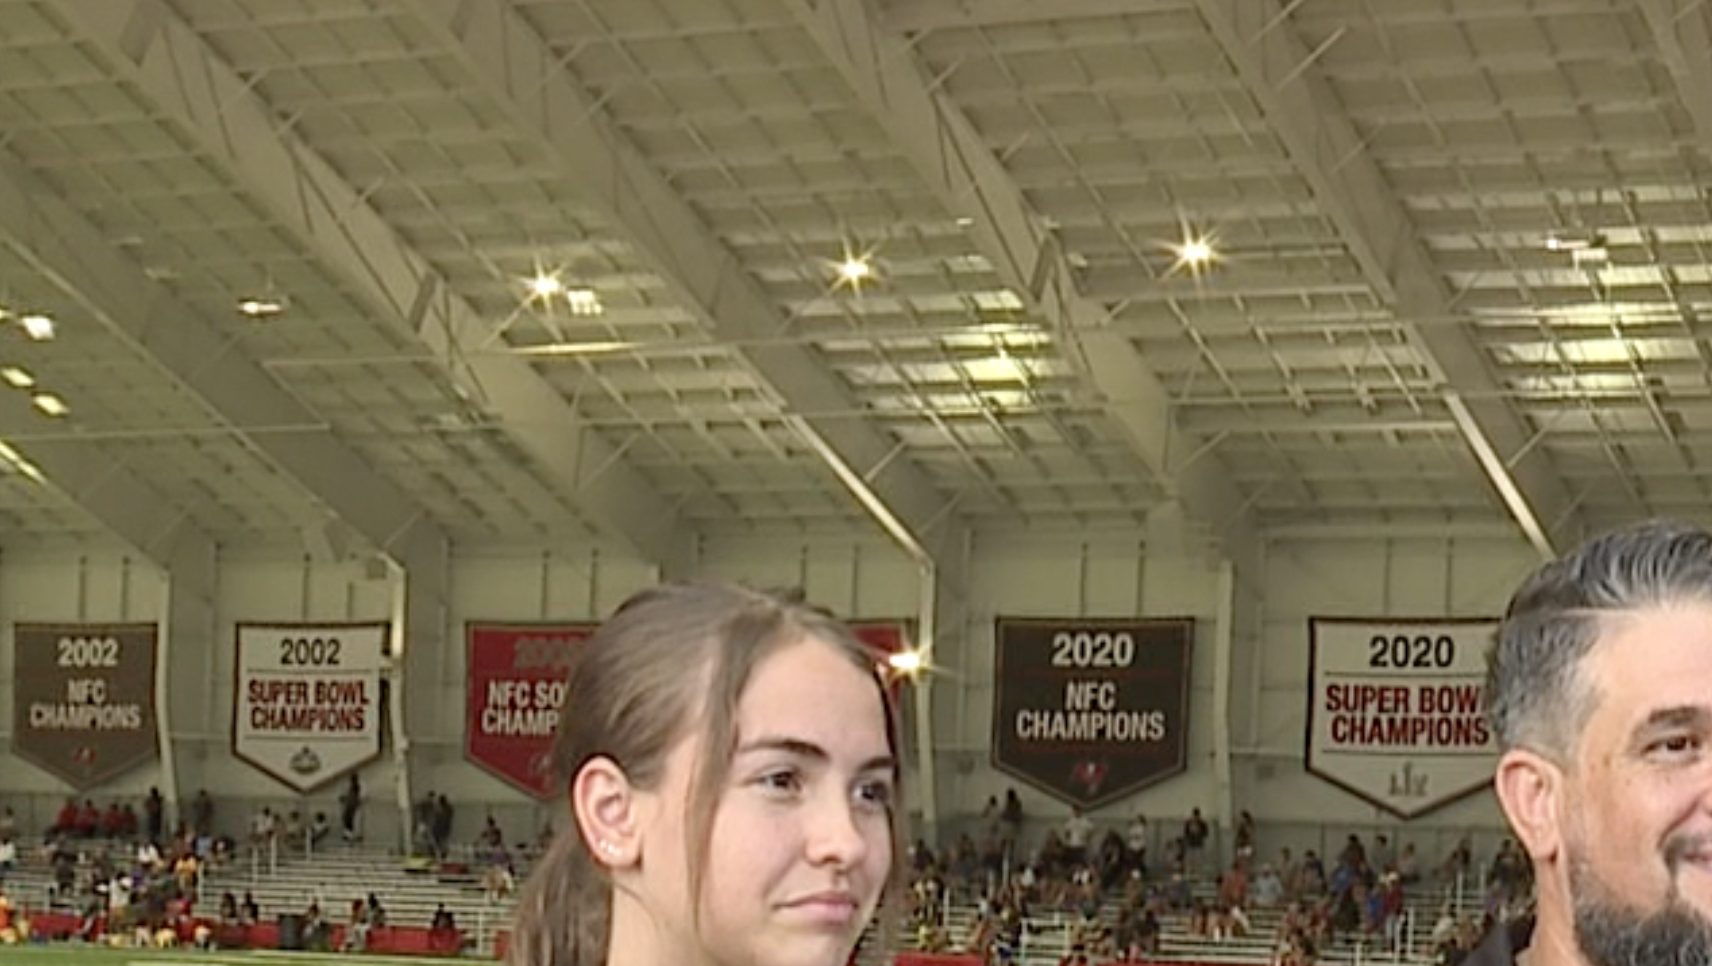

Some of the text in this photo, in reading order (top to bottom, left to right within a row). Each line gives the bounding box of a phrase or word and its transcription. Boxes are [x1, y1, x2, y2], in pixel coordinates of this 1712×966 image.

[57, 638, 119, 667] 2002
[280, 637, 340, 665] 2002
[1052, 632, 1134, 667] 2020
[1369, 635, 1455, 667] 2020
[67, 679, 105, 703] NFC
[248, 679, 369, 705] SUPER BOWL
[488, 680, 530, 707] NFC
[1065, 681, 1116, 711] NFC
[1326, 684, 1482, 714] SUPER BOW
[29, 703, 141, 730] CHAMPIONS
[251, 706, 364, 731] CHAMPIONS
[481, 708, 559, 735] CHAMP
[1015, 709, 1166, 741] CHAMPIONS
[1331, 715, 1490, 746] CHAMPIONS
